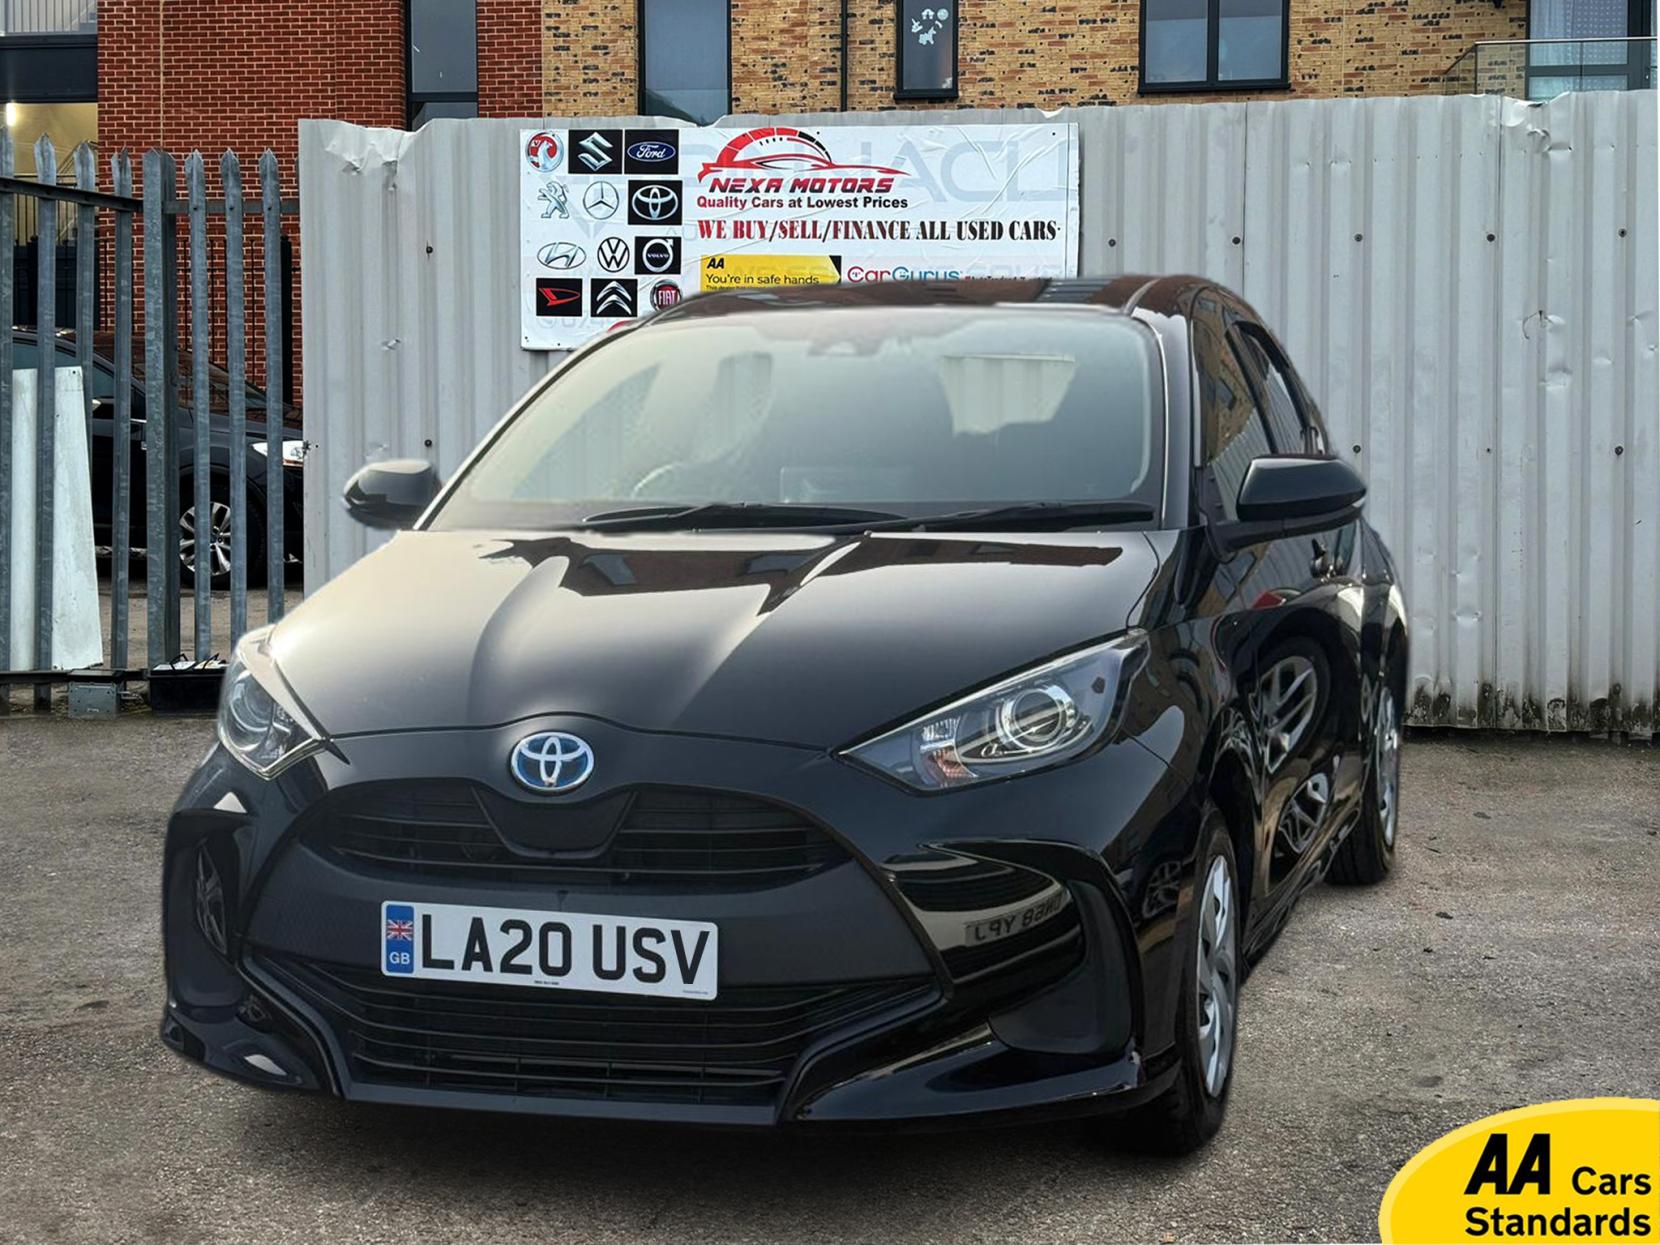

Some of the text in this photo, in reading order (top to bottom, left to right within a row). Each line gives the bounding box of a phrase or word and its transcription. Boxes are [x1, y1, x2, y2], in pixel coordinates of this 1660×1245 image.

[636, 144, 666, 159] Ford
[709, 177, 894, 194] NEXA MOTORS
[696, 196, 909, 210] Quality Cars at Lowest Prices
[697, 220, 727, 240] WE
[732, 219, 911, 243] BUY/SELL/FINANCE
[916, 220, 951, 240] ALL
[956, 220, 1004, 241] USED
[1008, 220, 1057, 241] CARS
[706, 258, 725, 269] AA
[705, 274, 819, 285] You're in safe hands
[658, 290, 677, 305] FIAT
[421, 913, 710, 985] LA20 USV
[390, 951, 410, 965] GB
